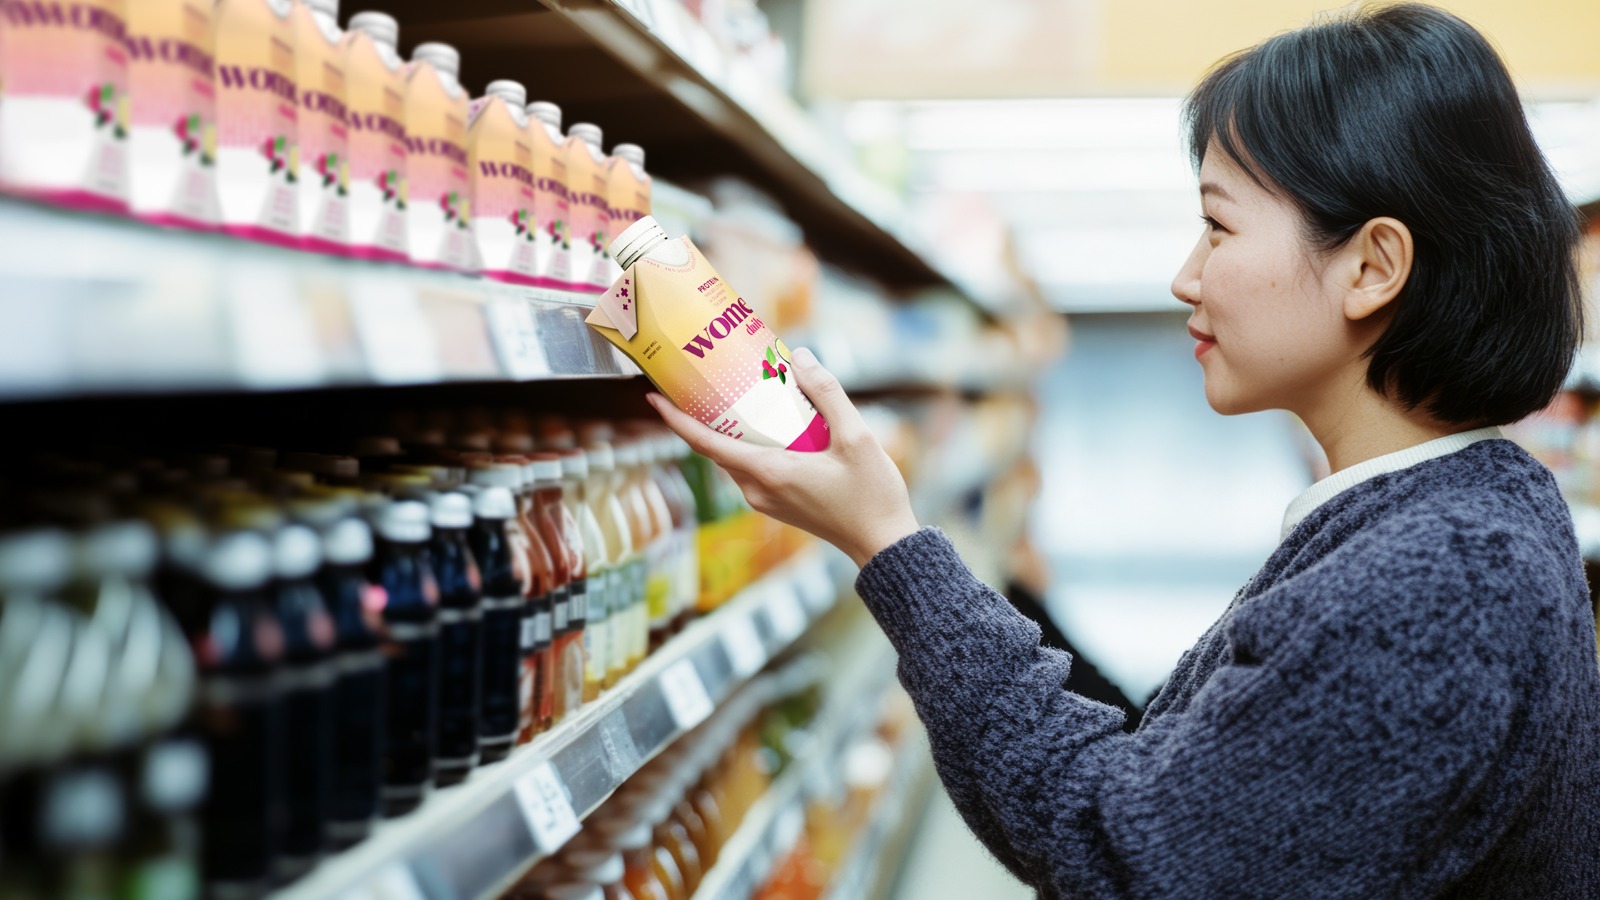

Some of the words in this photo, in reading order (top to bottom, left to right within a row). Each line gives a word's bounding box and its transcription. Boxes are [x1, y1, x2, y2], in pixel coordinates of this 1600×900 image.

[697, 276, 719, 293] PROTEIN
[682, 297, 754, 359] wome
[745, 317, 766, 336] daily
